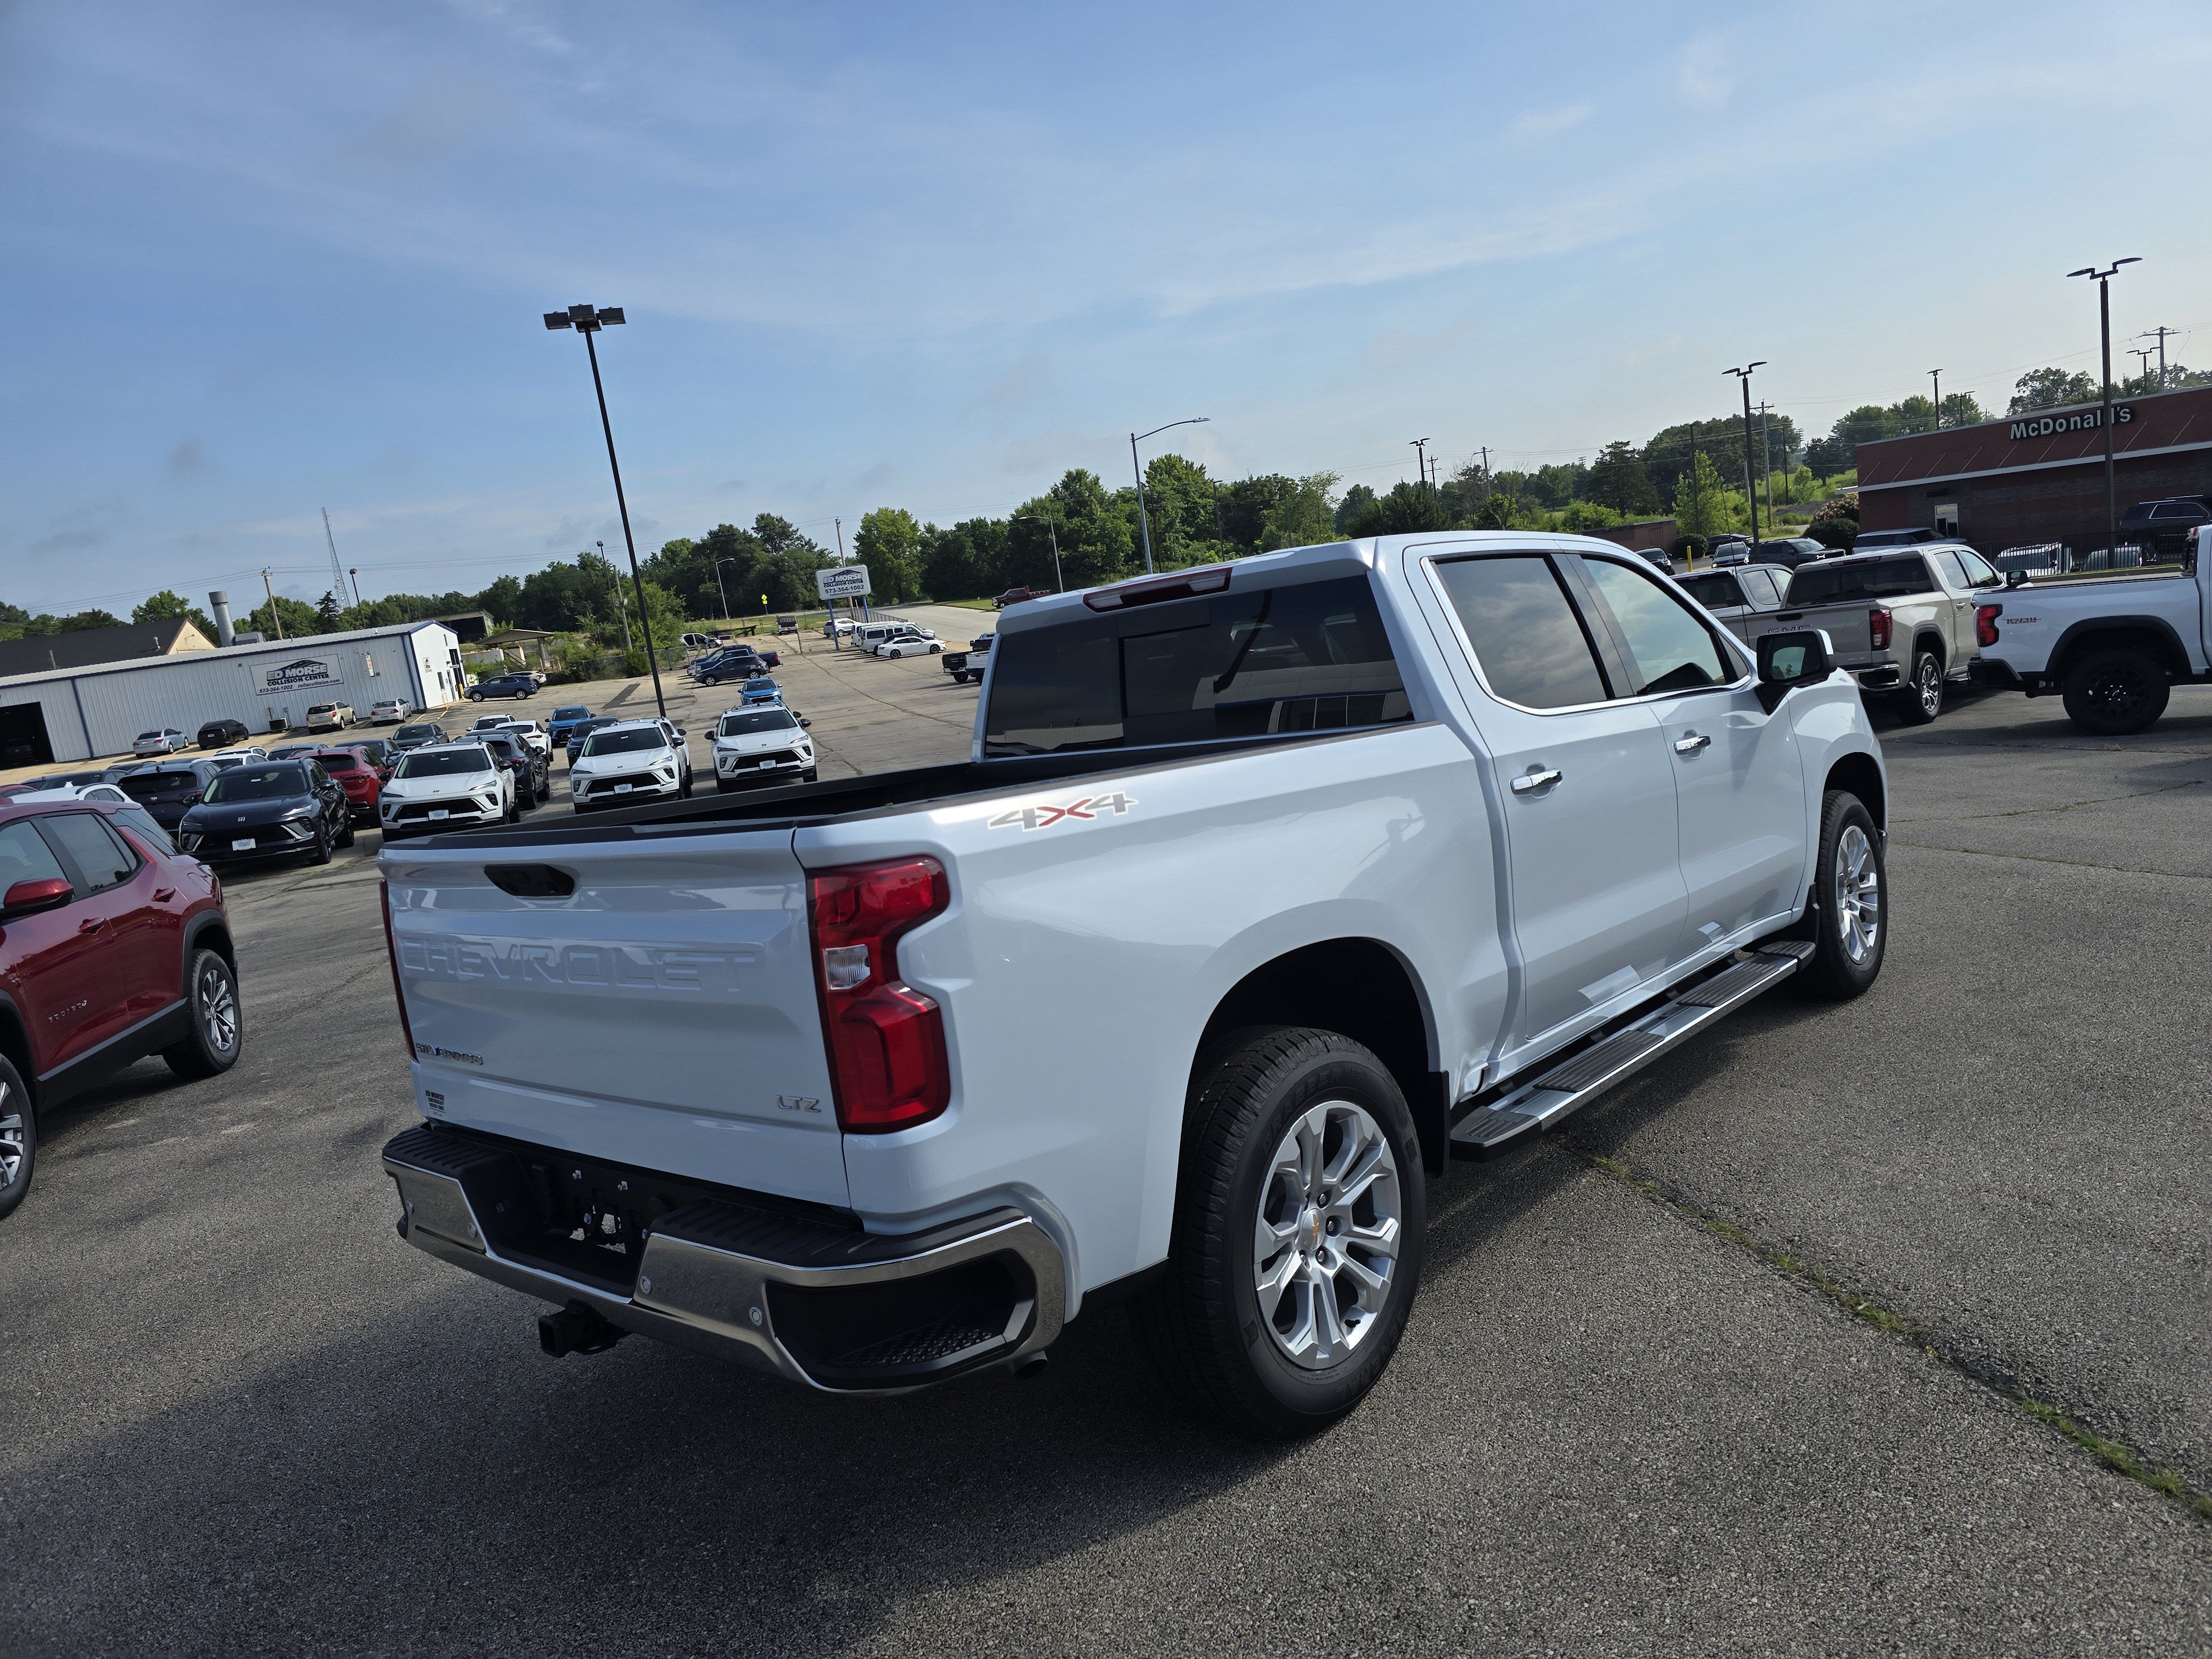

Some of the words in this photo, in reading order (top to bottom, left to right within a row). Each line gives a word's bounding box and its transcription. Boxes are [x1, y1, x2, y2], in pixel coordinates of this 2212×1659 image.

[835, 572, 863, 582] MORSE
[825, 585, 864, 594] 573-364-1002
[267, 670, 284, 681] ED
[285, 663, 328, 679] MORSE
[259, 685, 293, 693] 573-364-1002
[298, 679, 340, 688] rollacollision.com
[267, 677, 304, 686] COLLISION
[305, 674, 330, 682] CENTER
[399, 940, 756, 993] CHEVROLET
[776, 1094, 822, 1113] LTZ
